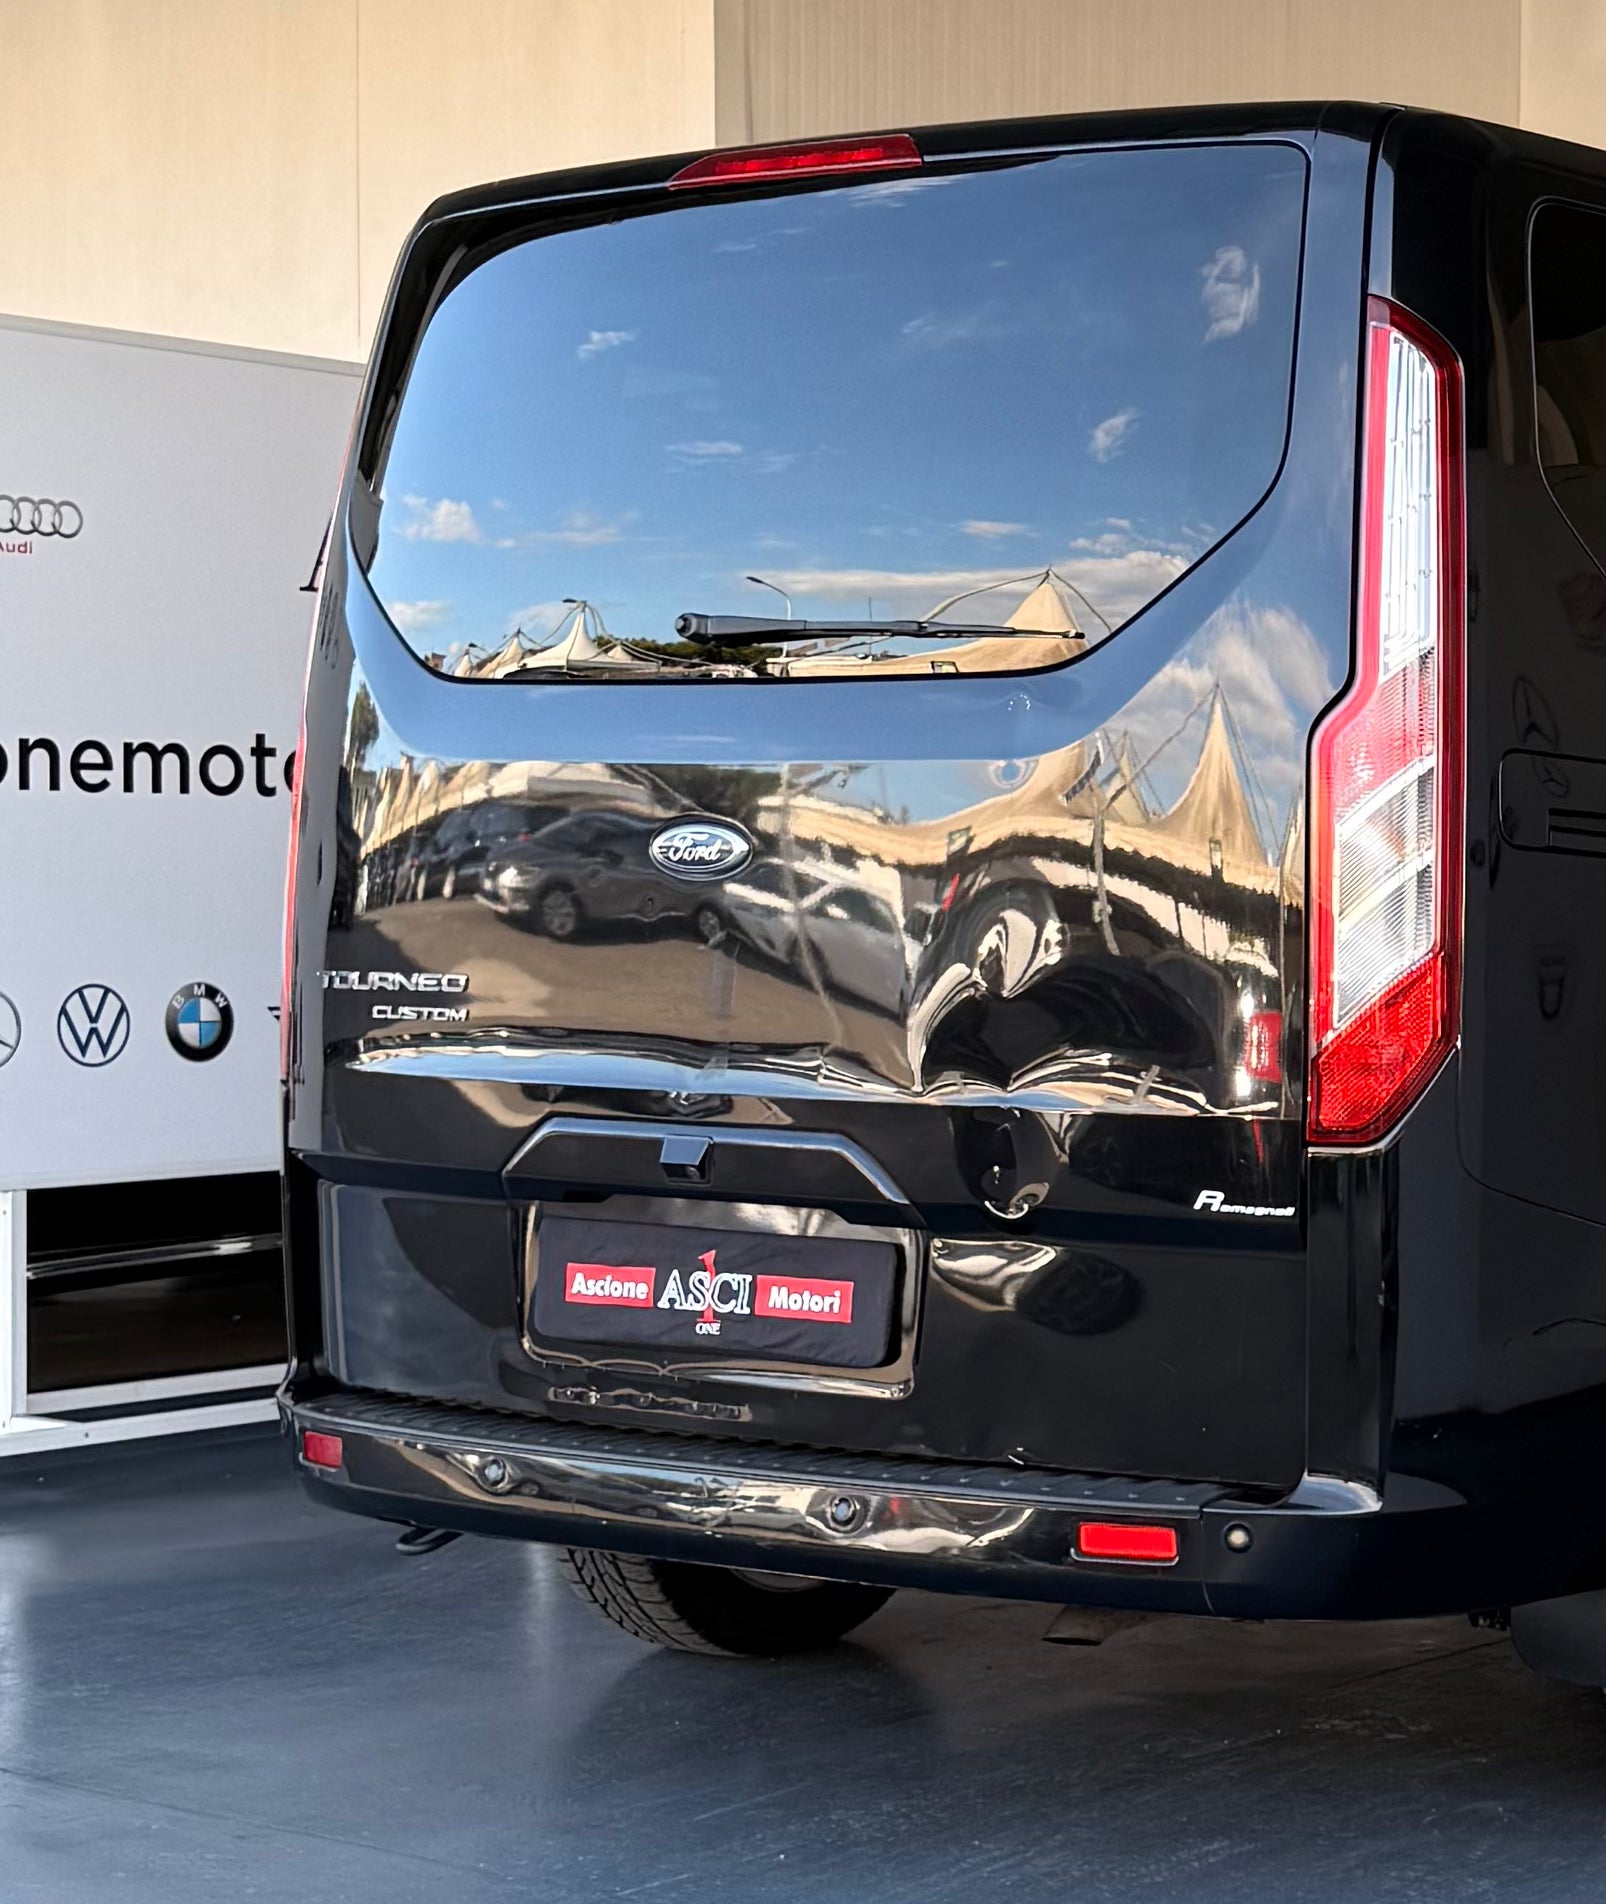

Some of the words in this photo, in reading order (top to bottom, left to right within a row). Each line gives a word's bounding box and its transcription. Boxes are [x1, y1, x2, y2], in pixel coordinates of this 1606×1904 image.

[0, 733, 300, 797] nemot
[668, 832, 722, 862] Ford
[322, 970, 468, 992] TOURNEO
[372, 1004, 468, 1023] CUSTOM
[570, 1272, 649, 1301] Ascione
[657, 1268, 754, 1315] ASCI
[768, 1286, 841, 1314] Motori
[695, 1322, 721, 1335] ONE
